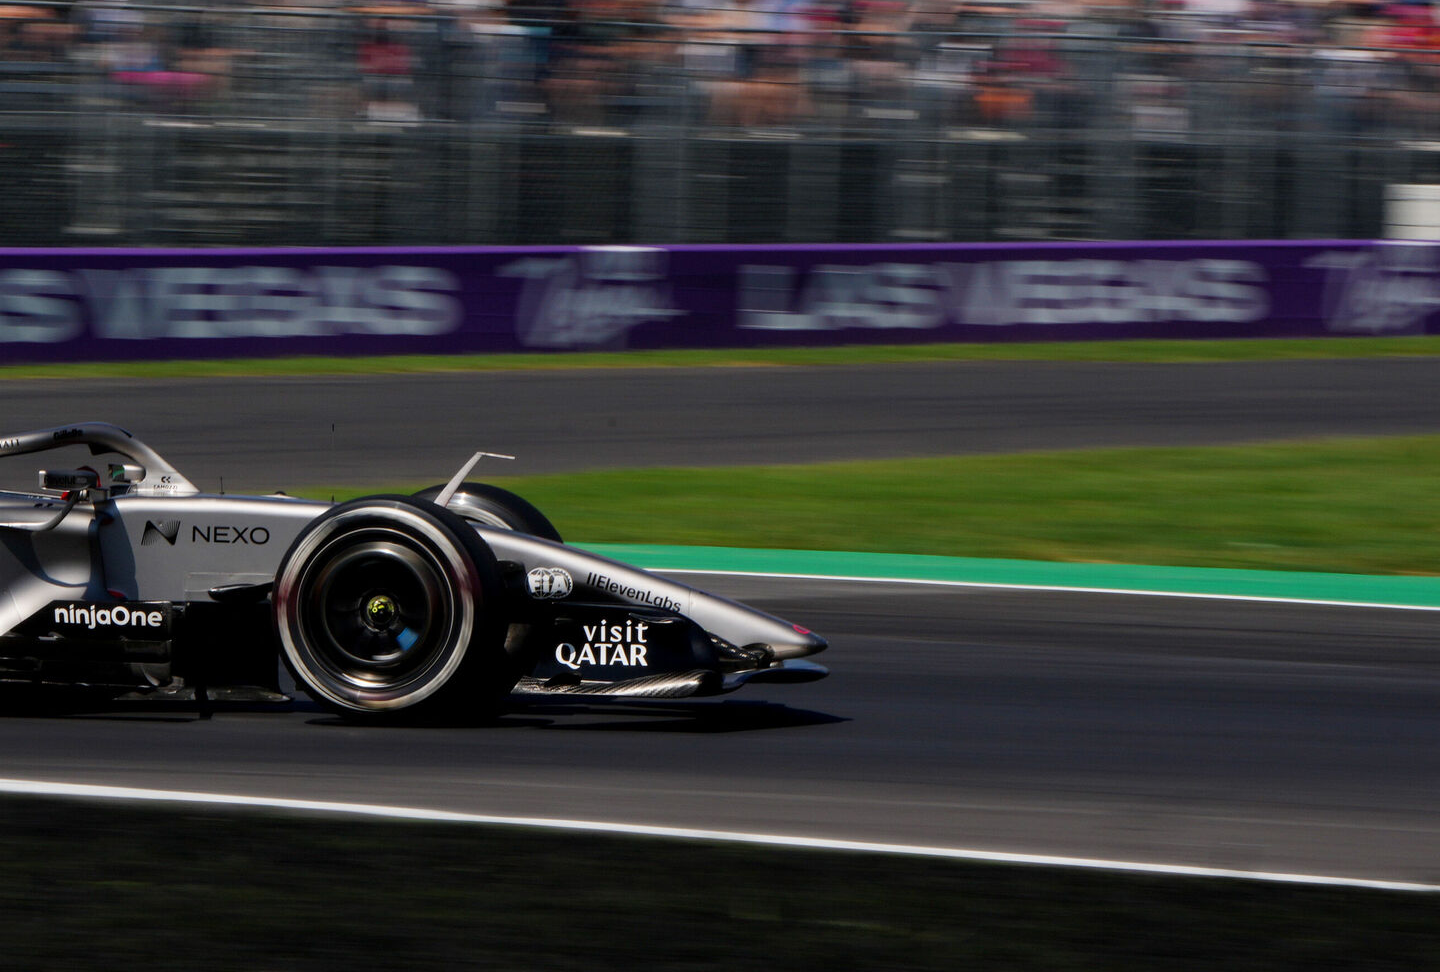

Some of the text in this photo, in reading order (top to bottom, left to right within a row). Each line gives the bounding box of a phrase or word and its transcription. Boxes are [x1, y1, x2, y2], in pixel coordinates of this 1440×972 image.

[75, 265, 462, 339] VEGAS
[738, 262, 955, 331] LAS
[955, 259, 1268, 326] VEGAS
[192, 525, 270, 545] NEXO
[54, 603, 163, 629] ninjaOne
[583, 619, 649, 643] visit
[555, 642, 648, 670] QATAR
